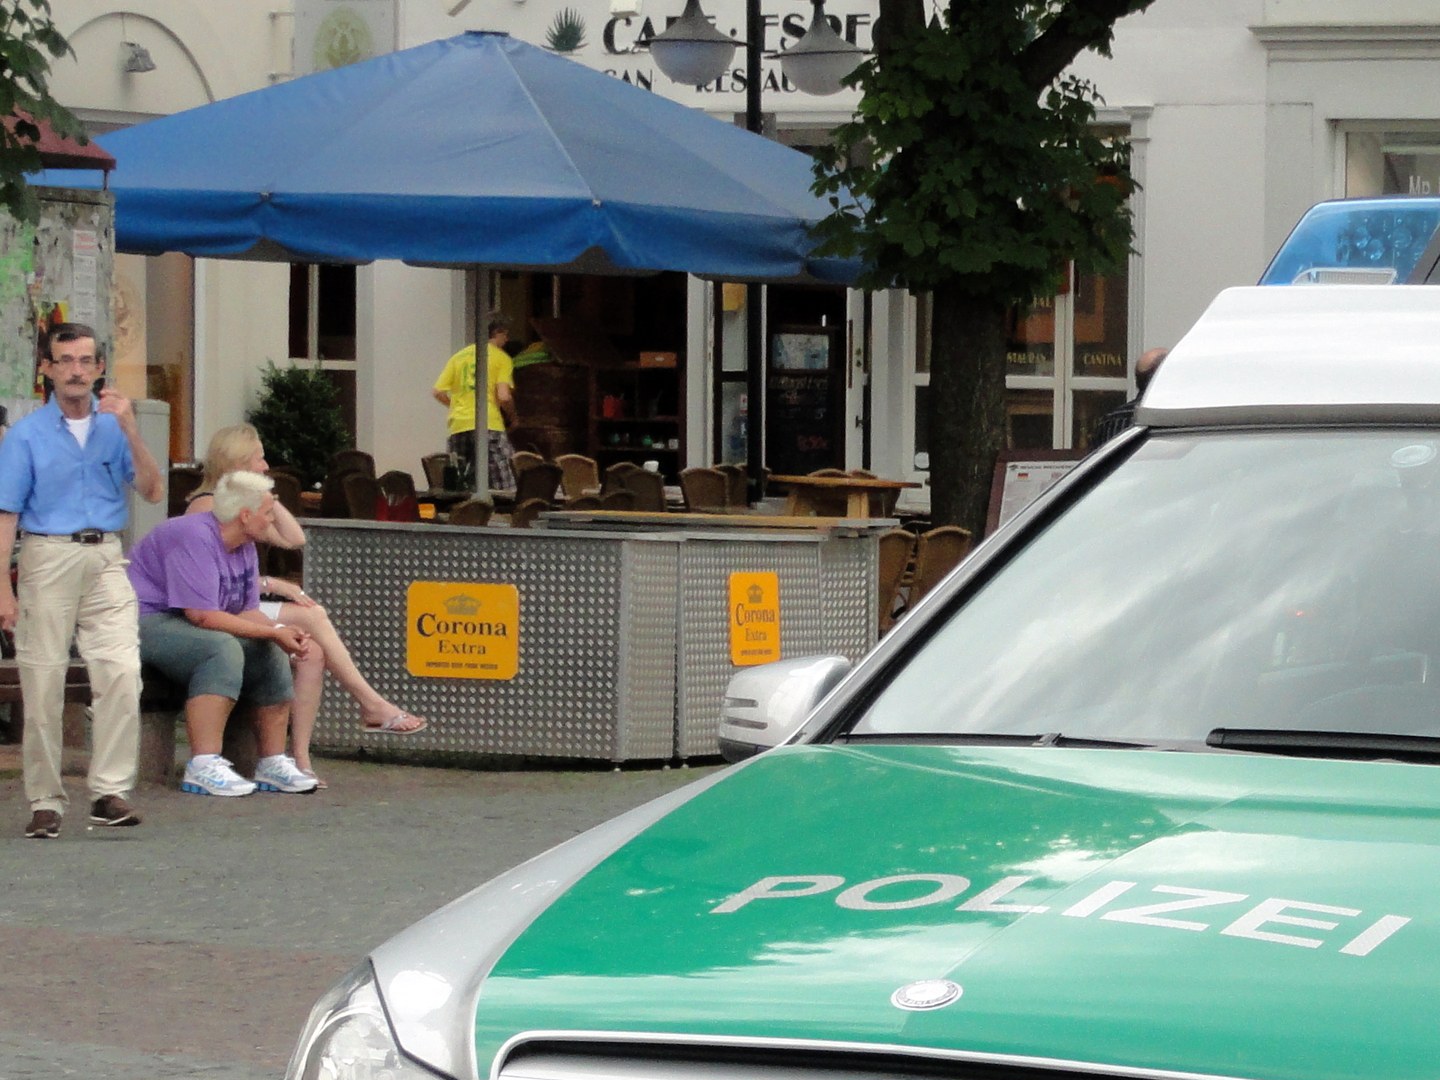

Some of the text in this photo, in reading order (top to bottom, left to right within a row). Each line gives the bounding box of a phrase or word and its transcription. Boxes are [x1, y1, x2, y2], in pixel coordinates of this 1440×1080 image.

[416, 612, 507, 638] Corona
[736, 602, 775, 627] Corona
[438, 639, 487, 656] Extra
[745, 628, 767, 642] Extra
[709, 873, 1412, 956] POLIZEI
